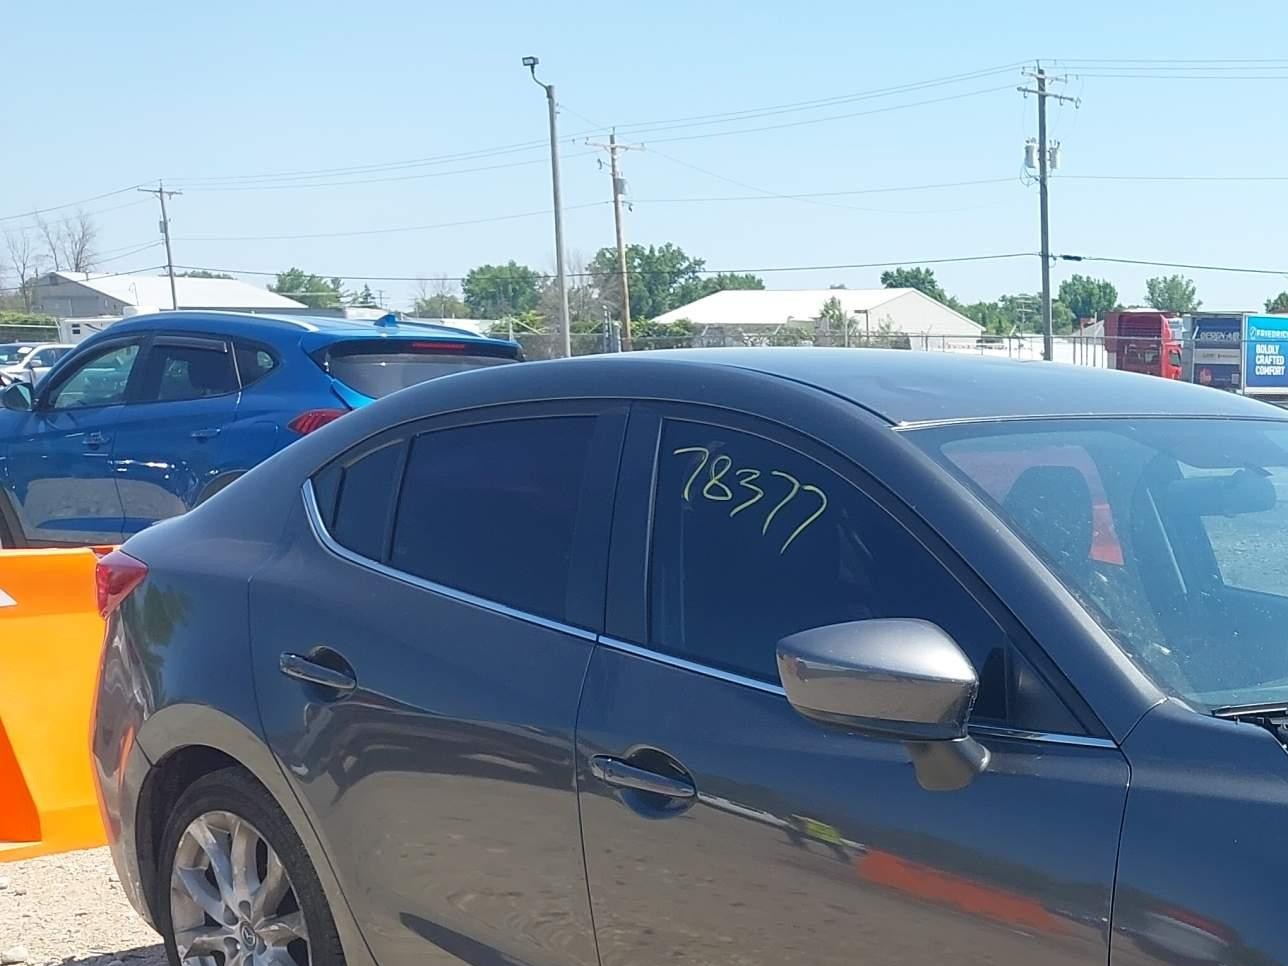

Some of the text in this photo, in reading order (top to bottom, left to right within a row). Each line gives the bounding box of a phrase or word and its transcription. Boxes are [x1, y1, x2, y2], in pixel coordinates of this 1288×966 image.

[1255, 344, 1280, 354] BOLDLY
[1255, 355, 1285, 365] CRAFTED
[1255, 366, 1286, 376] COMFORT
[673, 447, 827, 554] 78377
